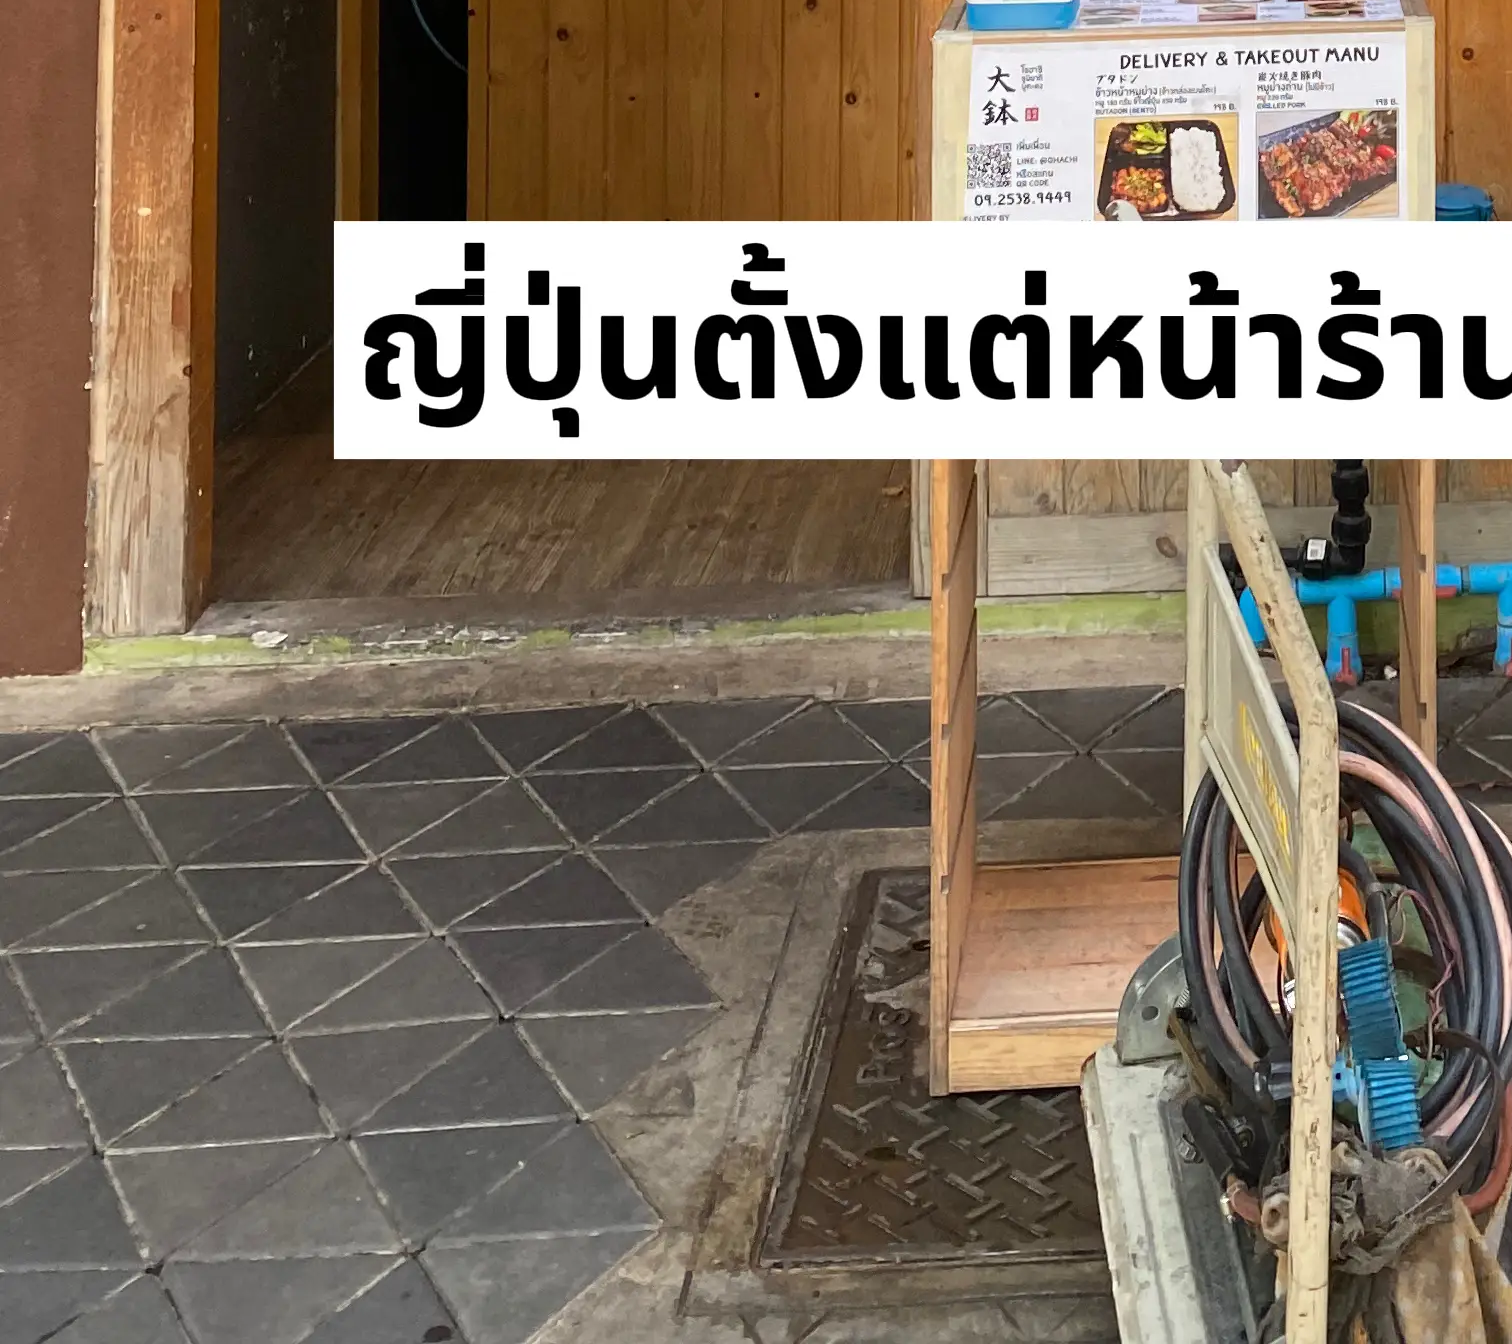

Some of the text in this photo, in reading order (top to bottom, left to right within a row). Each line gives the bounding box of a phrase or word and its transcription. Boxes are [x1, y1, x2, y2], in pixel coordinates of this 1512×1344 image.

[1120, 46, 1380, 70] DELIVERY & TAKEOUT MANU
[1039, 156, 1078, 165] @OHACHI
[1028, 179, 1049, 187] CODE
[974, 191, 1071, 206] 09.2538.9449
